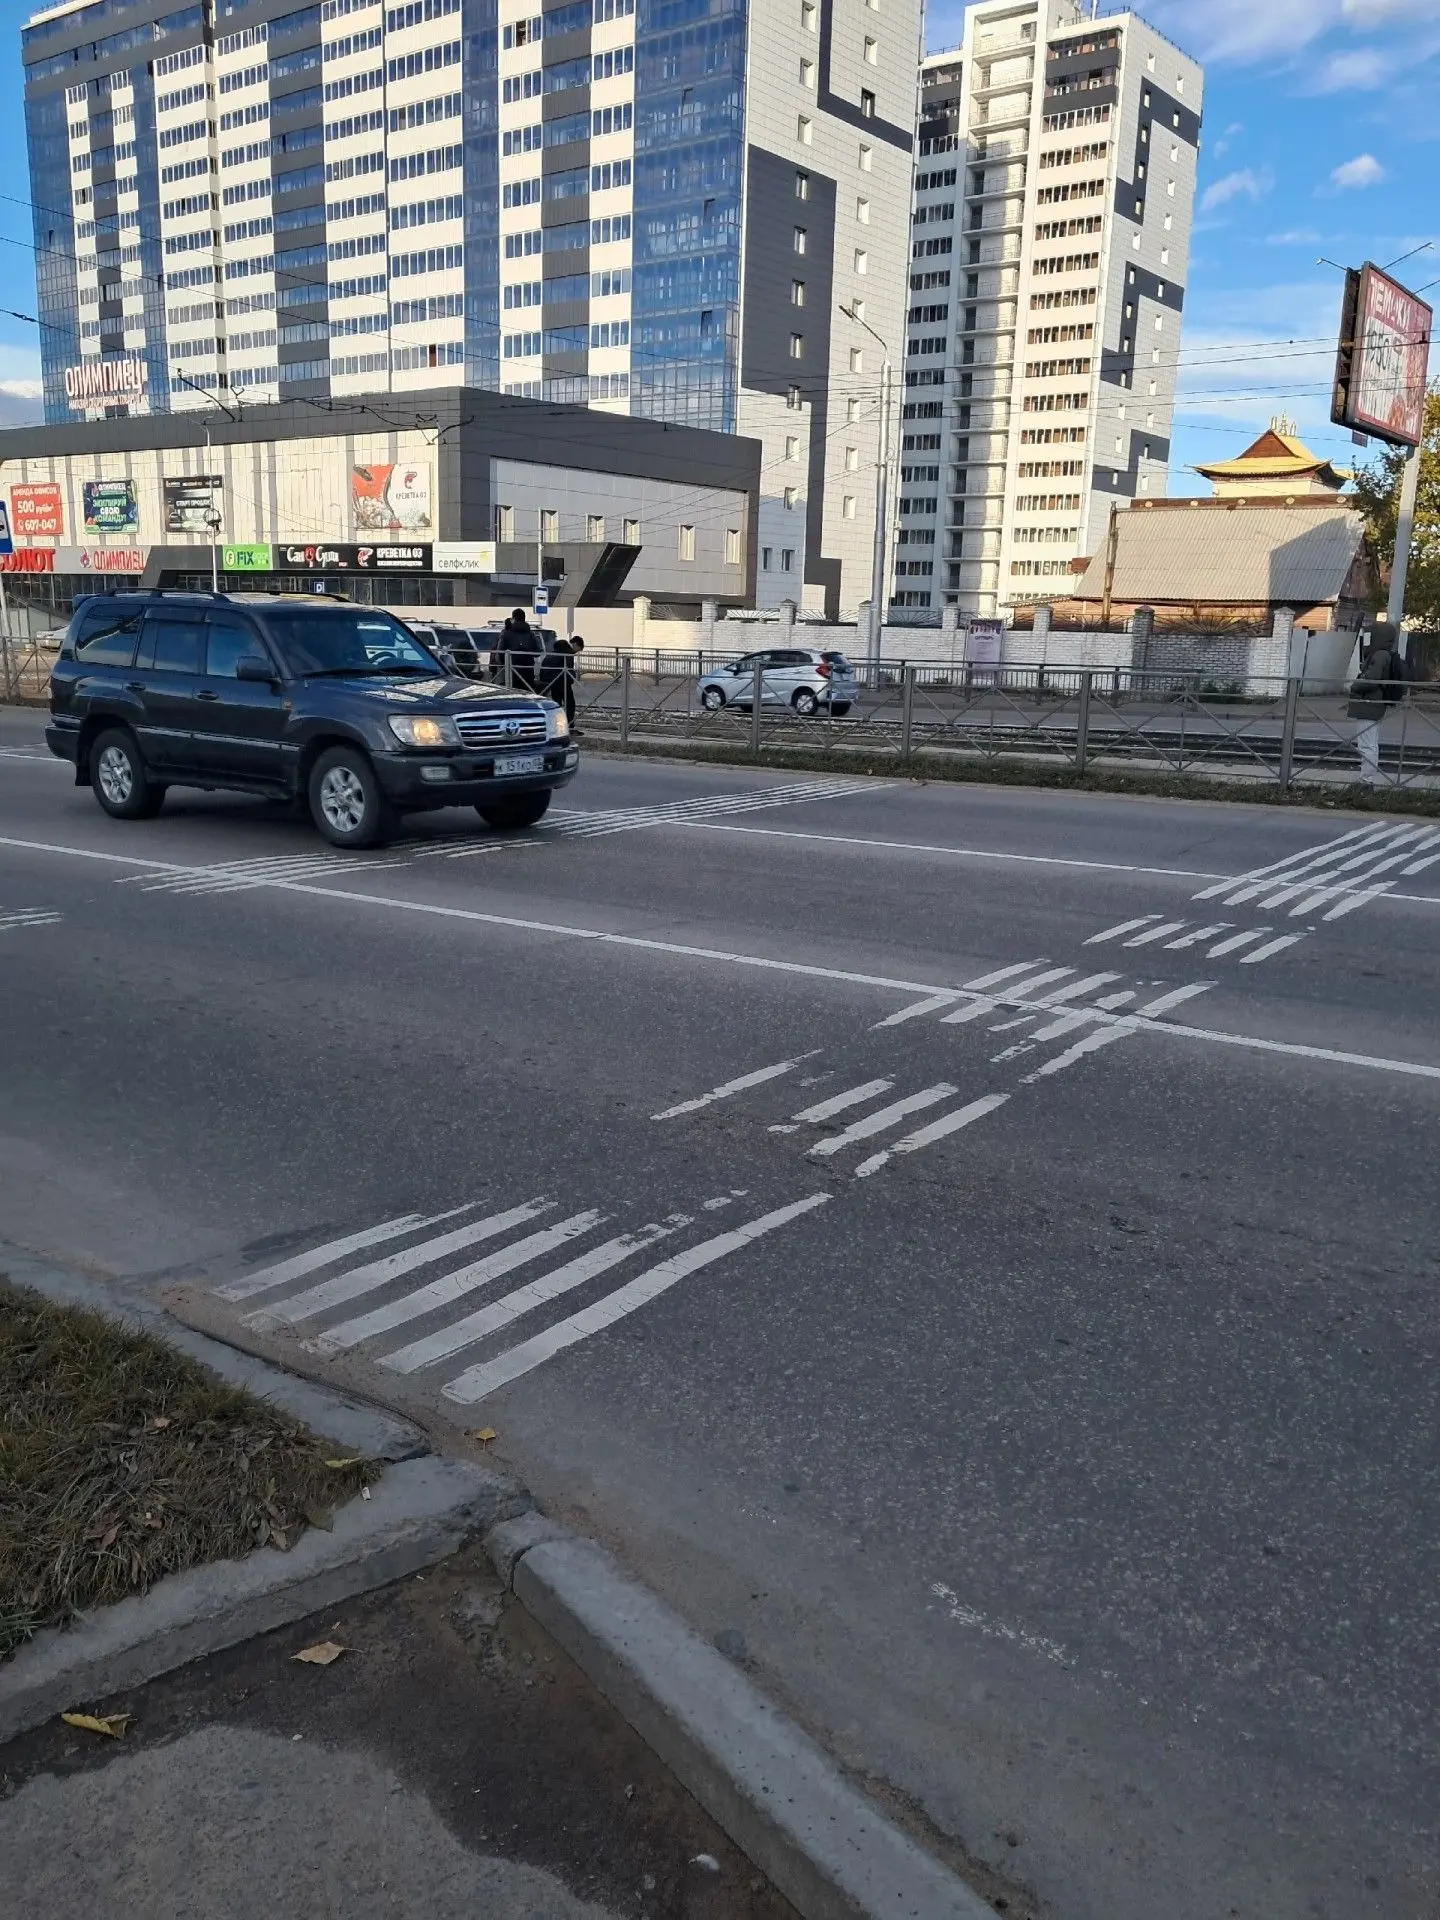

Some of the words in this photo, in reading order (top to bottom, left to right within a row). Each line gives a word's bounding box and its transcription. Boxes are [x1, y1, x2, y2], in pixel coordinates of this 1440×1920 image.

[65, 359, 143, 396] ОЛИМПИЕЦ
[17, 500, 35, 513] 500
[377, 548, 411, 558] КРЕВЕТКА
[93, 550, 144, 570] ОЛИМПИЕЦ
[439, 558, 480, 570] селфклик
